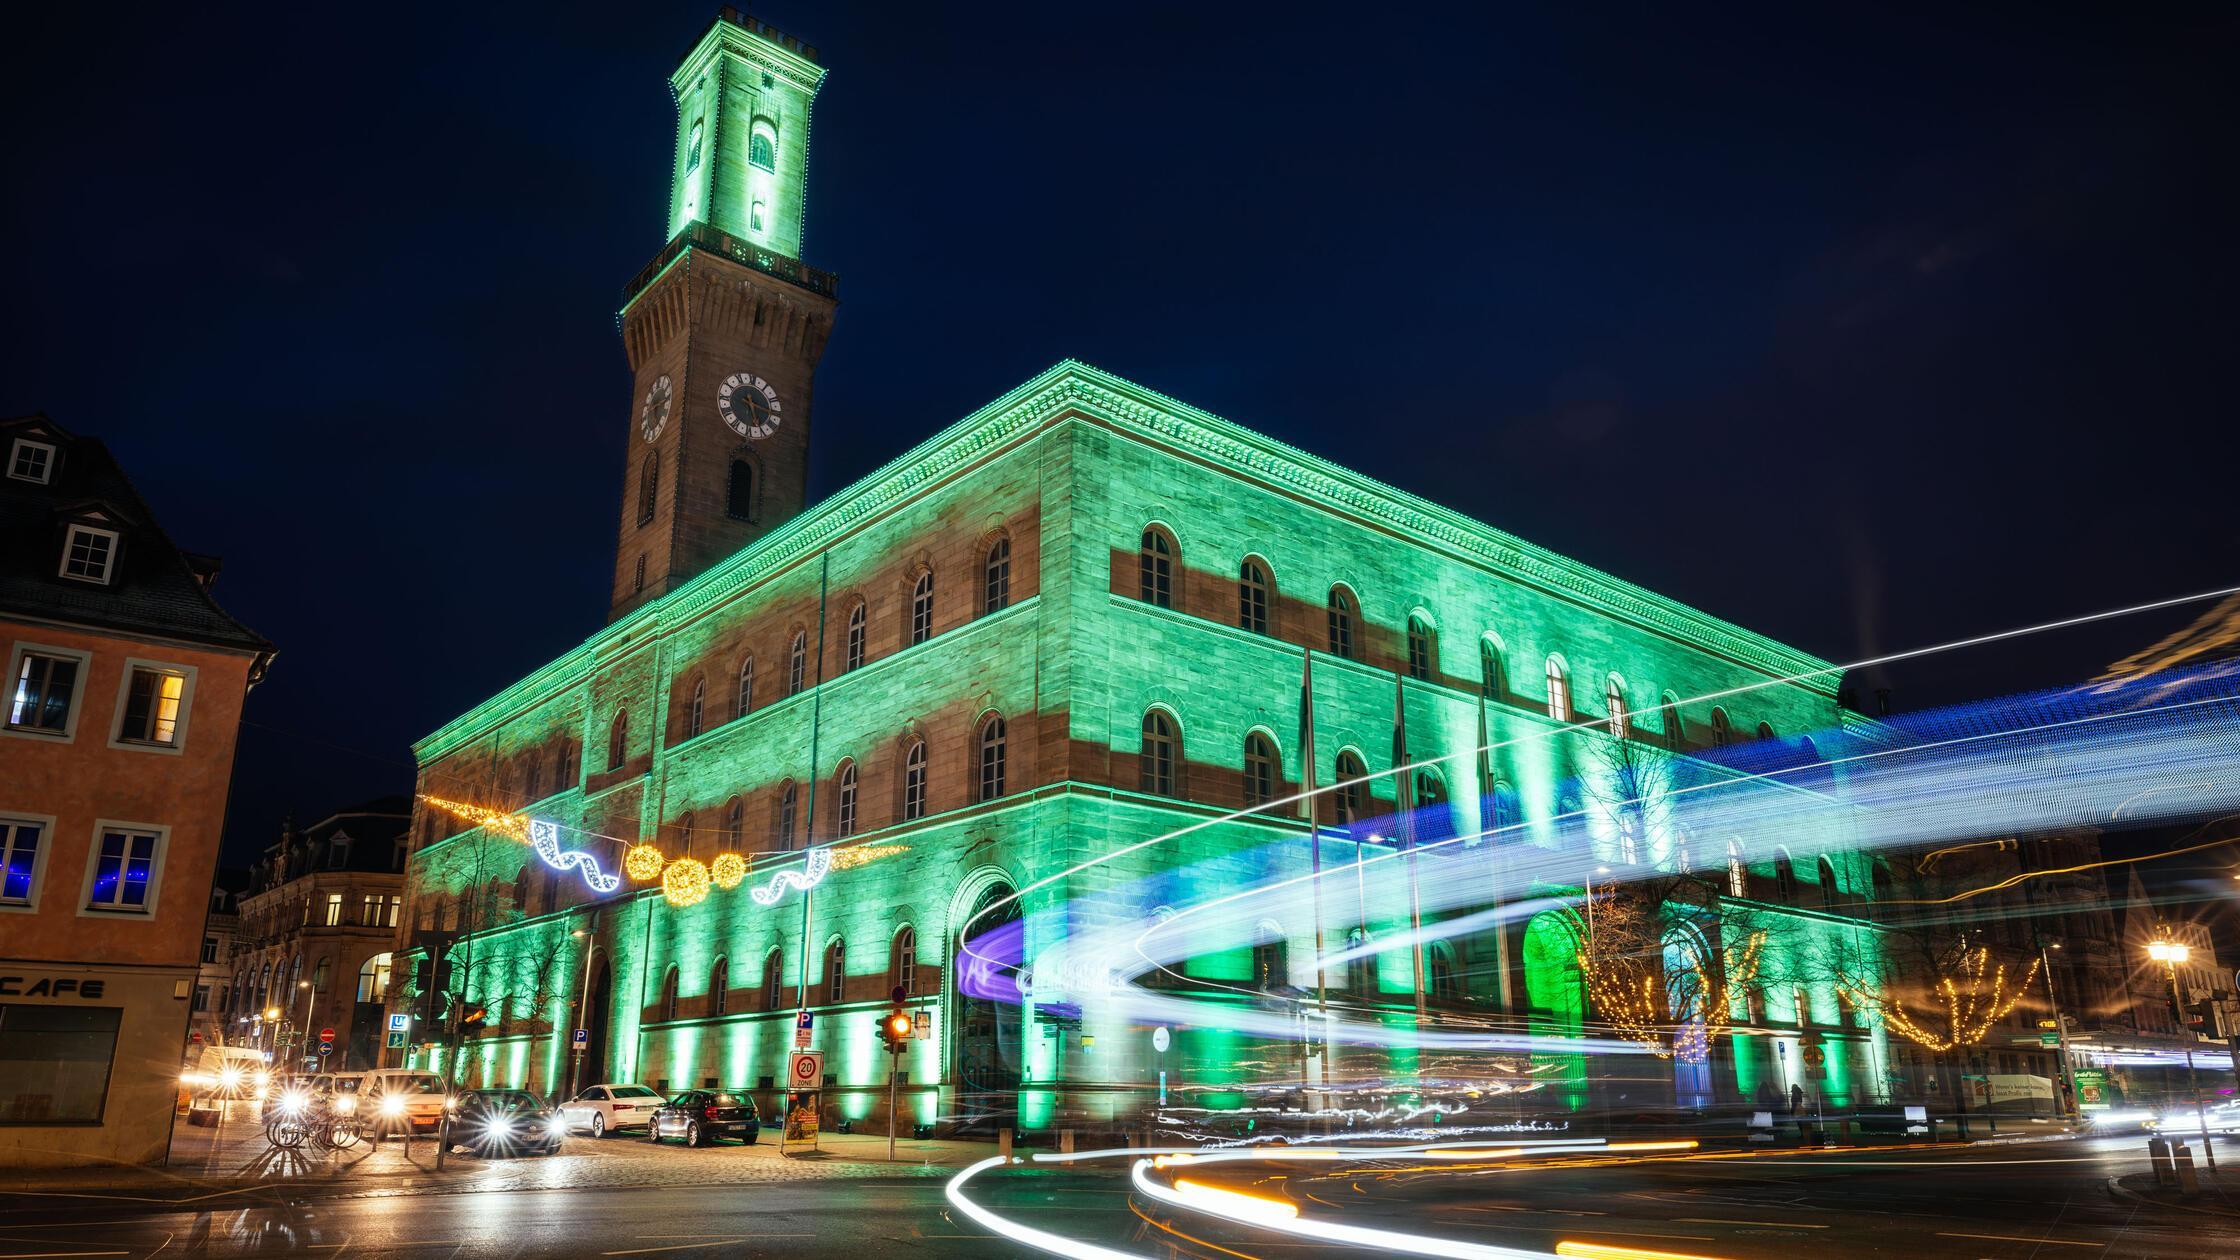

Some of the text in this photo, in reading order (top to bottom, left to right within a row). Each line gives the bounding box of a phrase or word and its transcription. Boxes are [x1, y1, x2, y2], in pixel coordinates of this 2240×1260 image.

[0, 977, 105, 998] CAFE
[395, 1016, 403, 1026] U
[800, 1013, 810, 1027] P
[576, 1031, 585, 1041] P
[800, 1063, 812, 1073] 20
